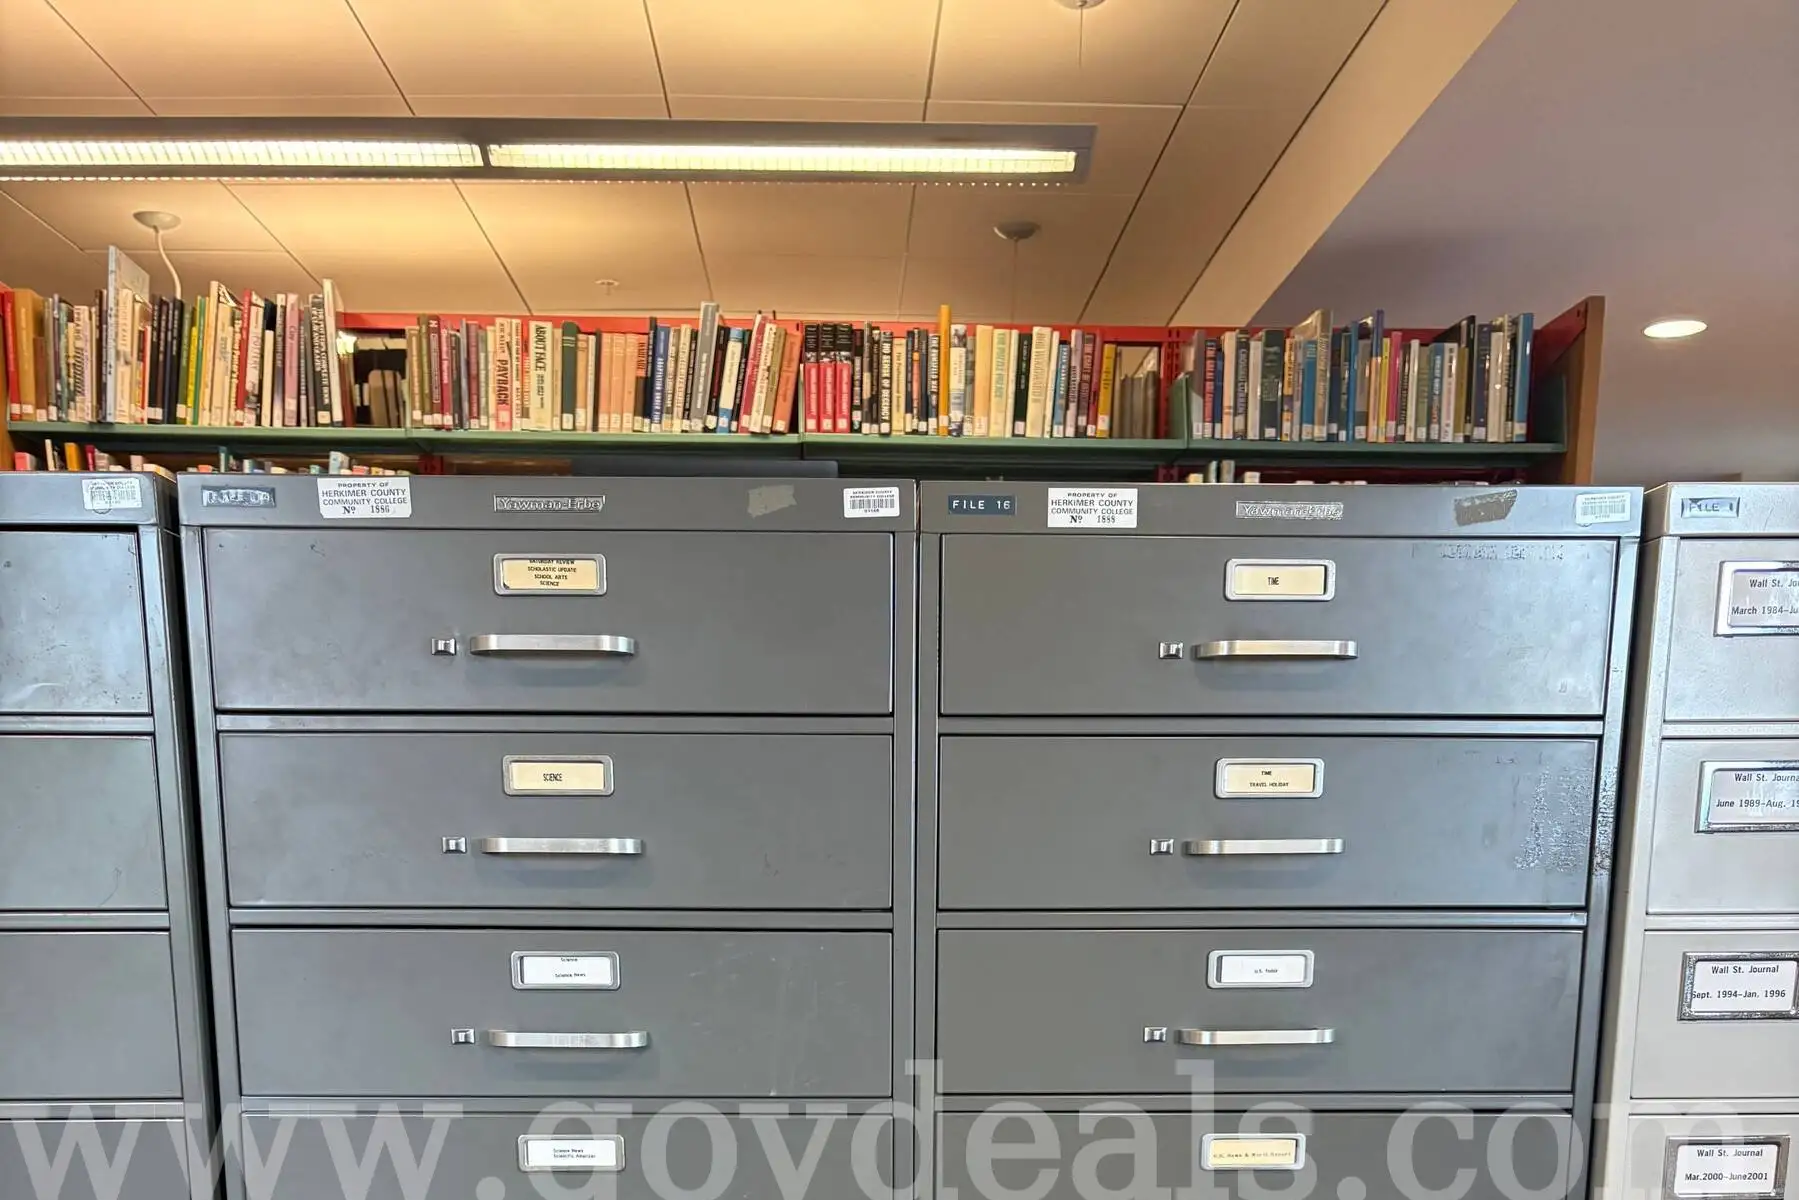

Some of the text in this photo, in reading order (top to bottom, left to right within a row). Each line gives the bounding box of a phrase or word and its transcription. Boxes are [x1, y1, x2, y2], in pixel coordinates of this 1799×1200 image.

[535, 325, 546, 350] ABOUT
[535, 352, 546, 371] FACE
[497, 359, 509, 406] PAYBACK
[882, 343, 890, 420] NO SENSE OF DECENCY
[500, 498, 600, 510] Yawman-Erbe
[952, 500, 1010, 509] FILE 16
[1689, 502, 1720, 512] FILE
[1268, 577, 1279, 585] TIME
[1749, 579, 1768, 588] Wall
[1771, 579, 1784, 588] St.
[1731, 607, 1757, 615] March
[543, 773, 563, 782] SCIENCE
[1735, 773, 1752, 782] Wall
[1756, 774, 1768, 782] St.
[1716, 799, 1735, 808] June
[1711, 965, 1779, 974] Wall St. Journal
[1692, 991, 1712, 999] Sept.
[1697, 1149, 1763, 1157] Wall St. Journal
